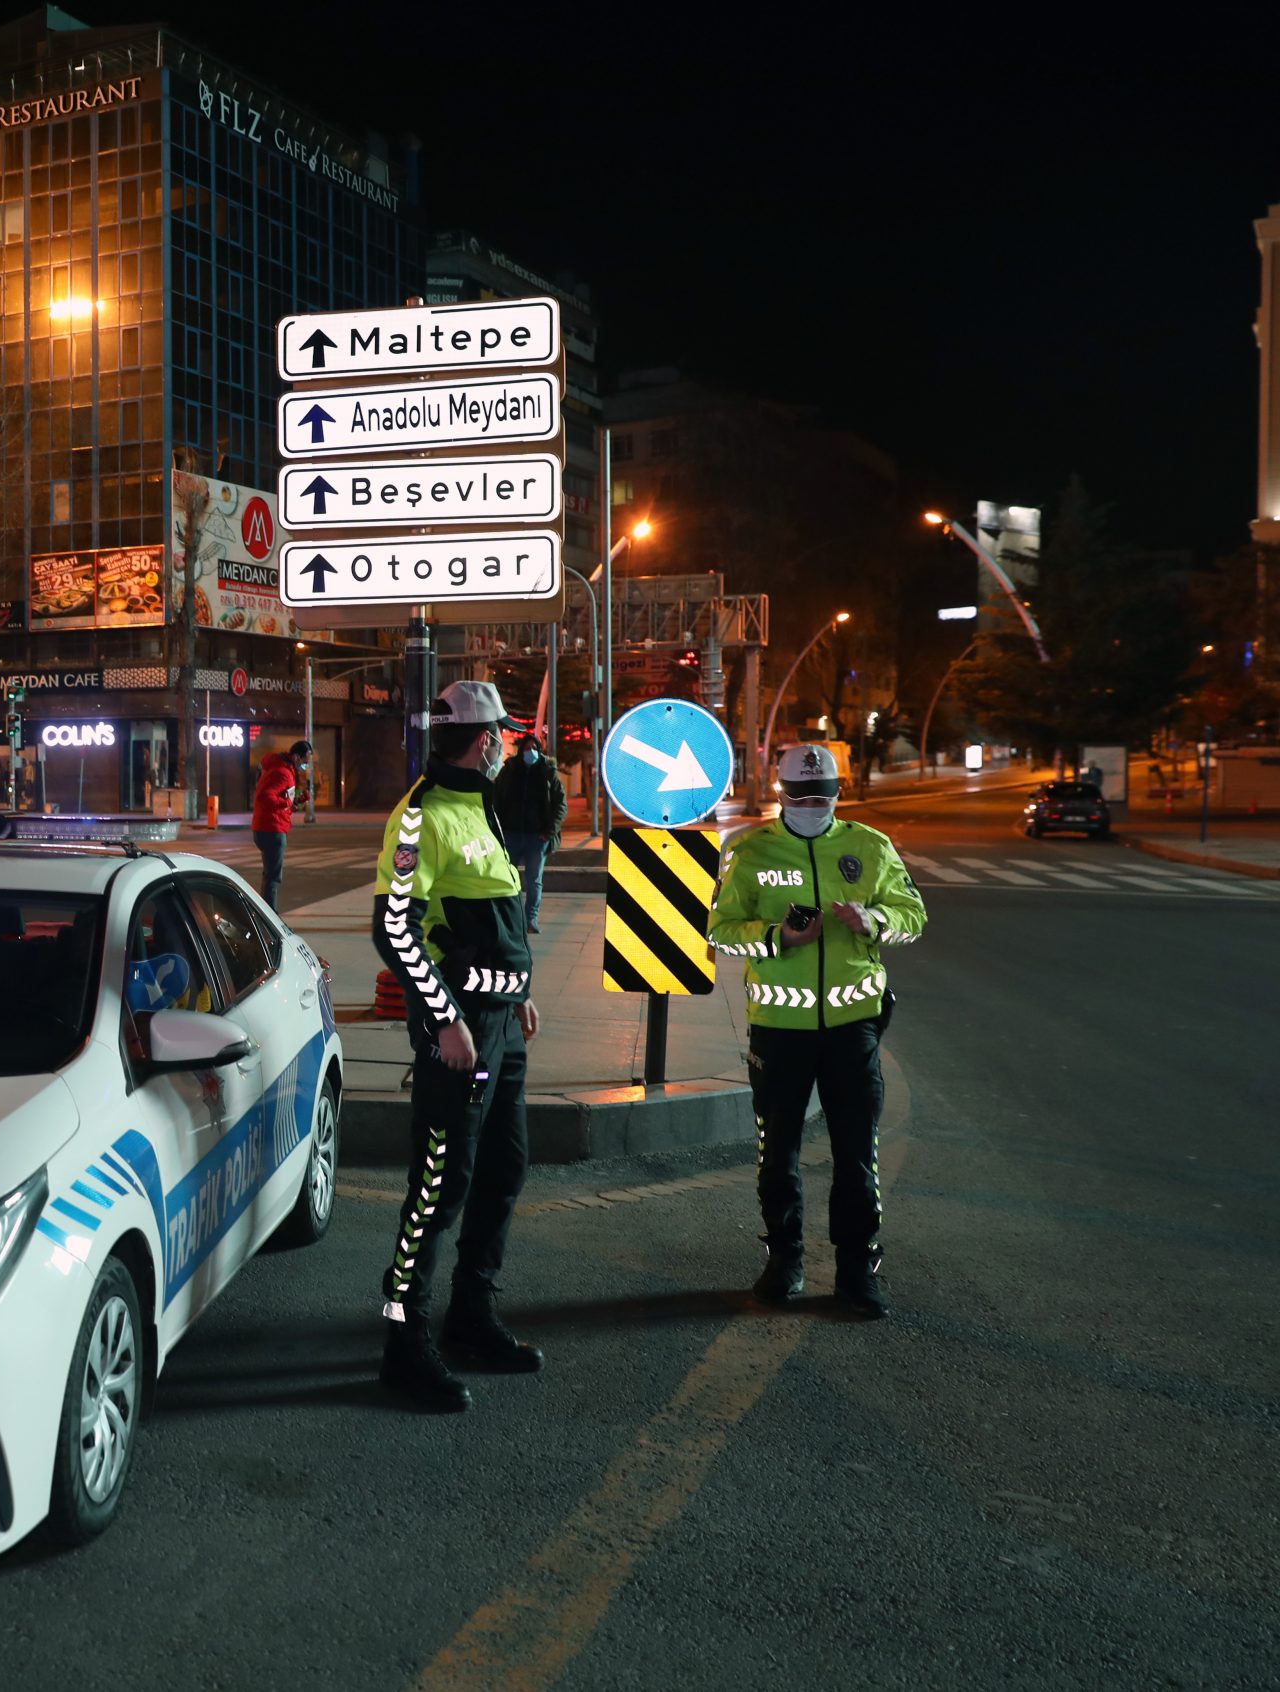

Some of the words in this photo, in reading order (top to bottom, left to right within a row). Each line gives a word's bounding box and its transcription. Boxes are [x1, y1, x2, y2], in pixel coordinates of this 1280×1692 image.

[218, 91, 262, 143] FLZ
[273, 128, 308, 164] CAFE
[322, 154, 399, 213] RESTAURANT
[350, 324, 531, 357] Maltepe
[350, 396, 440, 433] Anadolu
[449, 389, 541, 432] Meydanı
[351, 472, 537, 508] Beşevler
[131, 555, 150, 571] 50
[222, 562, 267, 585] MEYDAN
[350, 553, 530, 586] Otogar
[51, 573, 74, 589] 29
[0, 674, 59, 690] MEYDAN
[63, 673, 99, 688] CAFE
[249, 677, 283, 691] MEYDAN
[42, 721, 116, 747] COLIN'S
[198, 723, 244, 747] COLIN'S
[756, 869, 804, 887] POLİS
[167, 1167, 221, 1284] TRAFİK
[222, 1113, 263, 1219] POLİSİ
